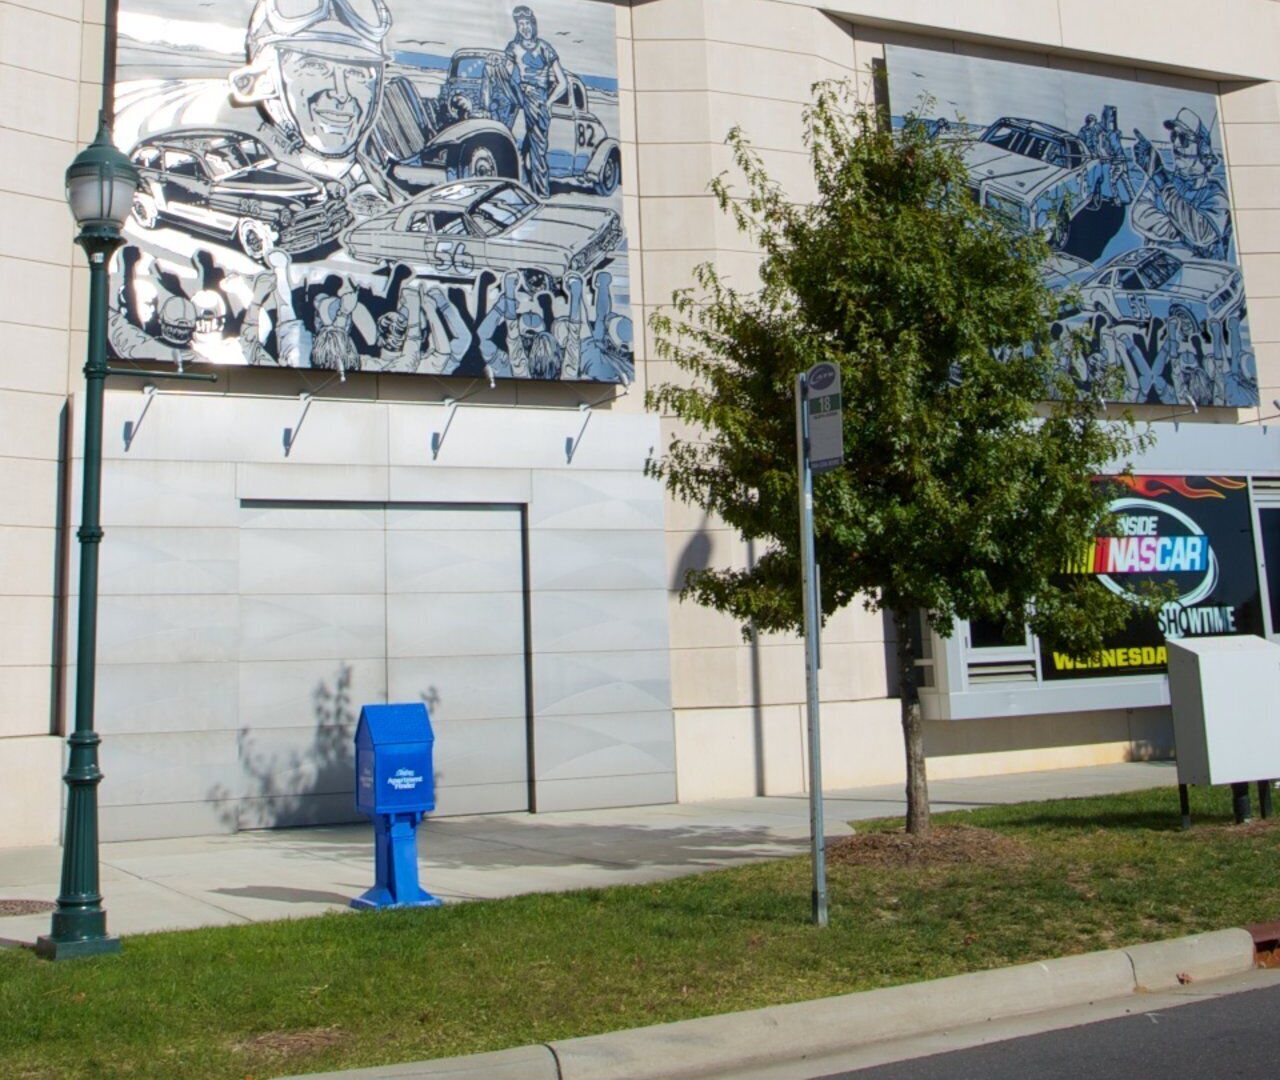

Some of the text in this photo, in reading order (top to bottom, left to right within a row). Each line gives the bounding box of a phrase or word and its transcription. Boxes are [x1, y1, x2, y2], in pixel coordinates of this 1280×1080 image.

[578, 123, 595, 147] 82
[433, 240, 475, 275] 56
[819, 397, 832, 412] 18
[1107, 536, 1202, 572] NASCAR
[1158, 606, 1237, 637] SHOWTIME
[1053, 646, 1168, 671] WEDNESDA
